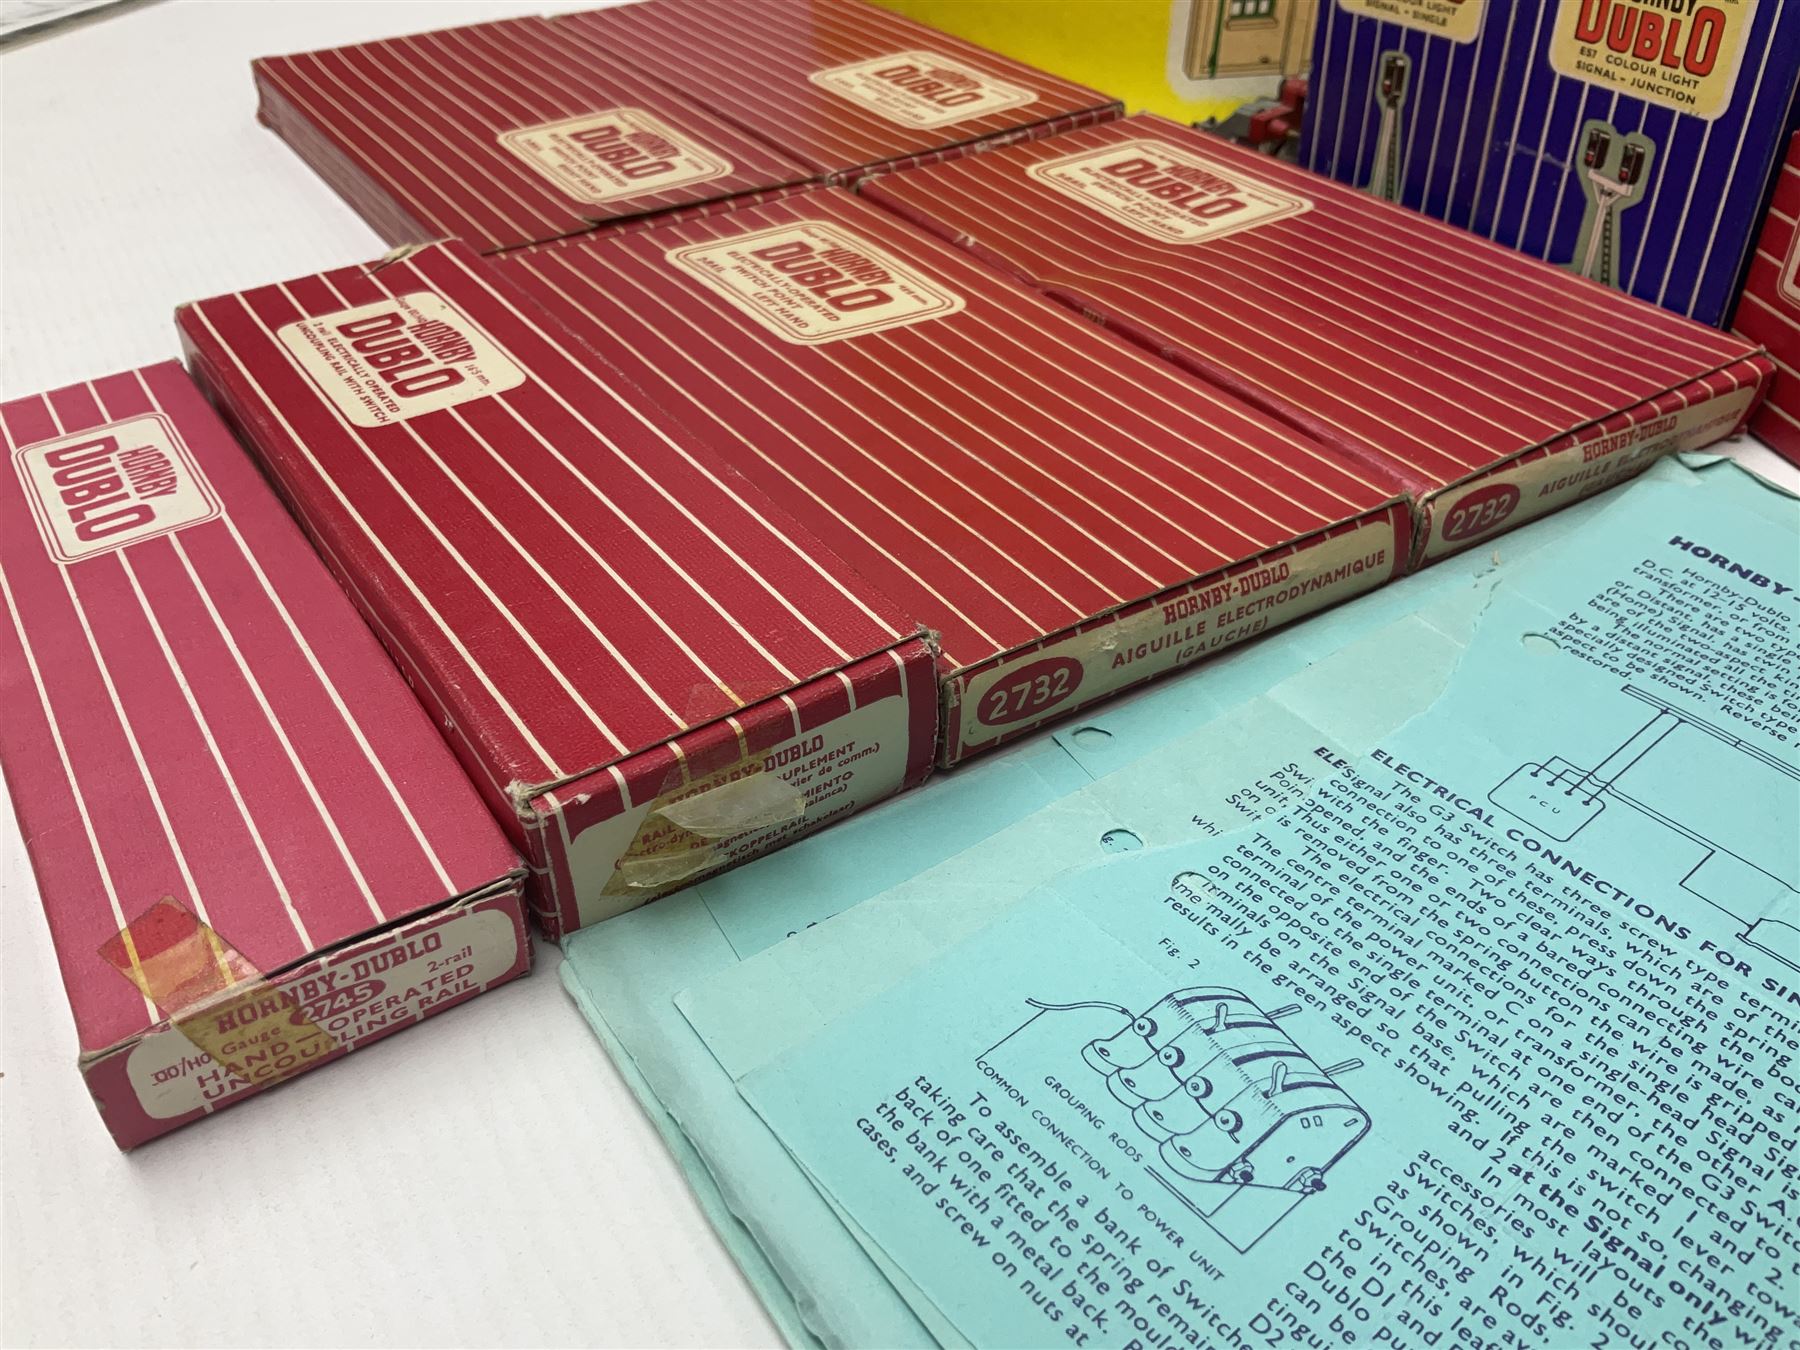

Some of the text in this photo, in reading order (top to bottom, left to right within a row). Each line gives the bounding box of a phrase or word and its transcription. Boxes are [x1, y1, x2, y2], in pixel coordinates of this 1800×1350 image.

[1575, 0, 1727, 77] DUBLO
[873, 64, 985, 108] DUBLO
[1576, 60, 1697, 105] SIGNAL JUNCTION
[1606, 54, 1657, 77] COLOUR
[1662, 68, 1700, 89] LIGHT
[566, 125, 677, 180] DUBLO
[1099, 158, 1248, 220] DUBLO
[750, 240, 895, 313] DUBLO
[770, 285, 805, 311] POINT
[815, 247, 896, 288] HORNBY
[407, 319, 478, 366] HORNBY
[775, 306, 809, 329] HAND
[296, 322, 391, 424] UNCOUPLING RAIL WITH SWITCH
[328, 336, 370, 381] ELECTRICALLY
[364, 378, 401, 414] OPERATED
[335, 311, 466, 399] DUBLO
[1581, 415, 1678, 463] HORNBY-DUBLO
[44, 435, 156, 542] DUBLO
[116, 444, 178, 501] HORNBY
[1447, 492, 1513, 537] 2732
[1163, 562, 1290, 625] HORNBY-DUBLO
[1668, 536, 1793, 595] HORNBY
[1682, 568, 1791, 622] Hornby-Dublo
[1111, 549, 1387, 669] AIGUILLE ELECTRODYNAMIQUE
[1659, 588, 1729, 626] There are
[1680, 580, 1696, 588] at
[1752, 612, 1790, 634] volts.
[1729, 614, 1749, 622] or
[1752, 623, 1790, 643] from
[1175, 616, 1270, 665] (GAUCHE)
[1563, 645, 1632, 680] restored.
[989, 667, 1071, 721] 2732
[1650, 674, 1787, 742] shown. Reverse
[1240, 788, 1261, 804] on
[1370, 748, 1752, 978] ELECTRICAL CONNECTIONS FOR
[1392, 780, 1729, 990] The G3 Switch has three screw type
[216, 931, 443, 1037] HORNBY-DUBLO
[1158, 937, 1200, 969] Fig. 2
[299, 945, 474, 1025] 2745 2-rail
[414, 977, 479, 1014] RAIL
[196, 963, 475, 1089] HAND OPERATED
[222, 1026, 282, 1056] Gauge
[1044, 1076, 1143, 1162] GROUPING RODS
[1163, 896, 1219, 936] results
[1220, 936, 1239, 950] in
[1243, 950, 1272, 974] the
[1271, 974, 1327, 1012] green
[1331, 1012, 1391, 1058] aspect
[1394, 1058, 1480, 1125] showing.
[1522, 1147, 1561, 1178] this
[1567, 1180, 1586, 1196] is
[1592, 1198, 1632, 1230] not
[1637, 1231, 1668, 1260] so,
[1678, 1260, 1784, 1344] changing
[895, 1086, 1110, 1295] back of one fitted to the
[915, 1075, 1144, 1295] taking care that the spring
[969, 1091, 1175, 1279] To assemble a bank of
[976, 1060, 1225, 1281] COMMON CONNECTION TO POWER UNIT
[1418, 1150, 1535, 1239] accessories
[856, 1118, 1089, 1347] cases, and screw on nuts at
[876, 1103, 1108, 1334] the bank with a metal back.
[1403, 1162, 1498, 1244] Switches,
[1448, 1121, 1728, 1326] and 2 at the Signal only
[1303, 1260, 1370, 1321] Dublo
[1373, 1196, 1549, 1344] Grouping Rods,
